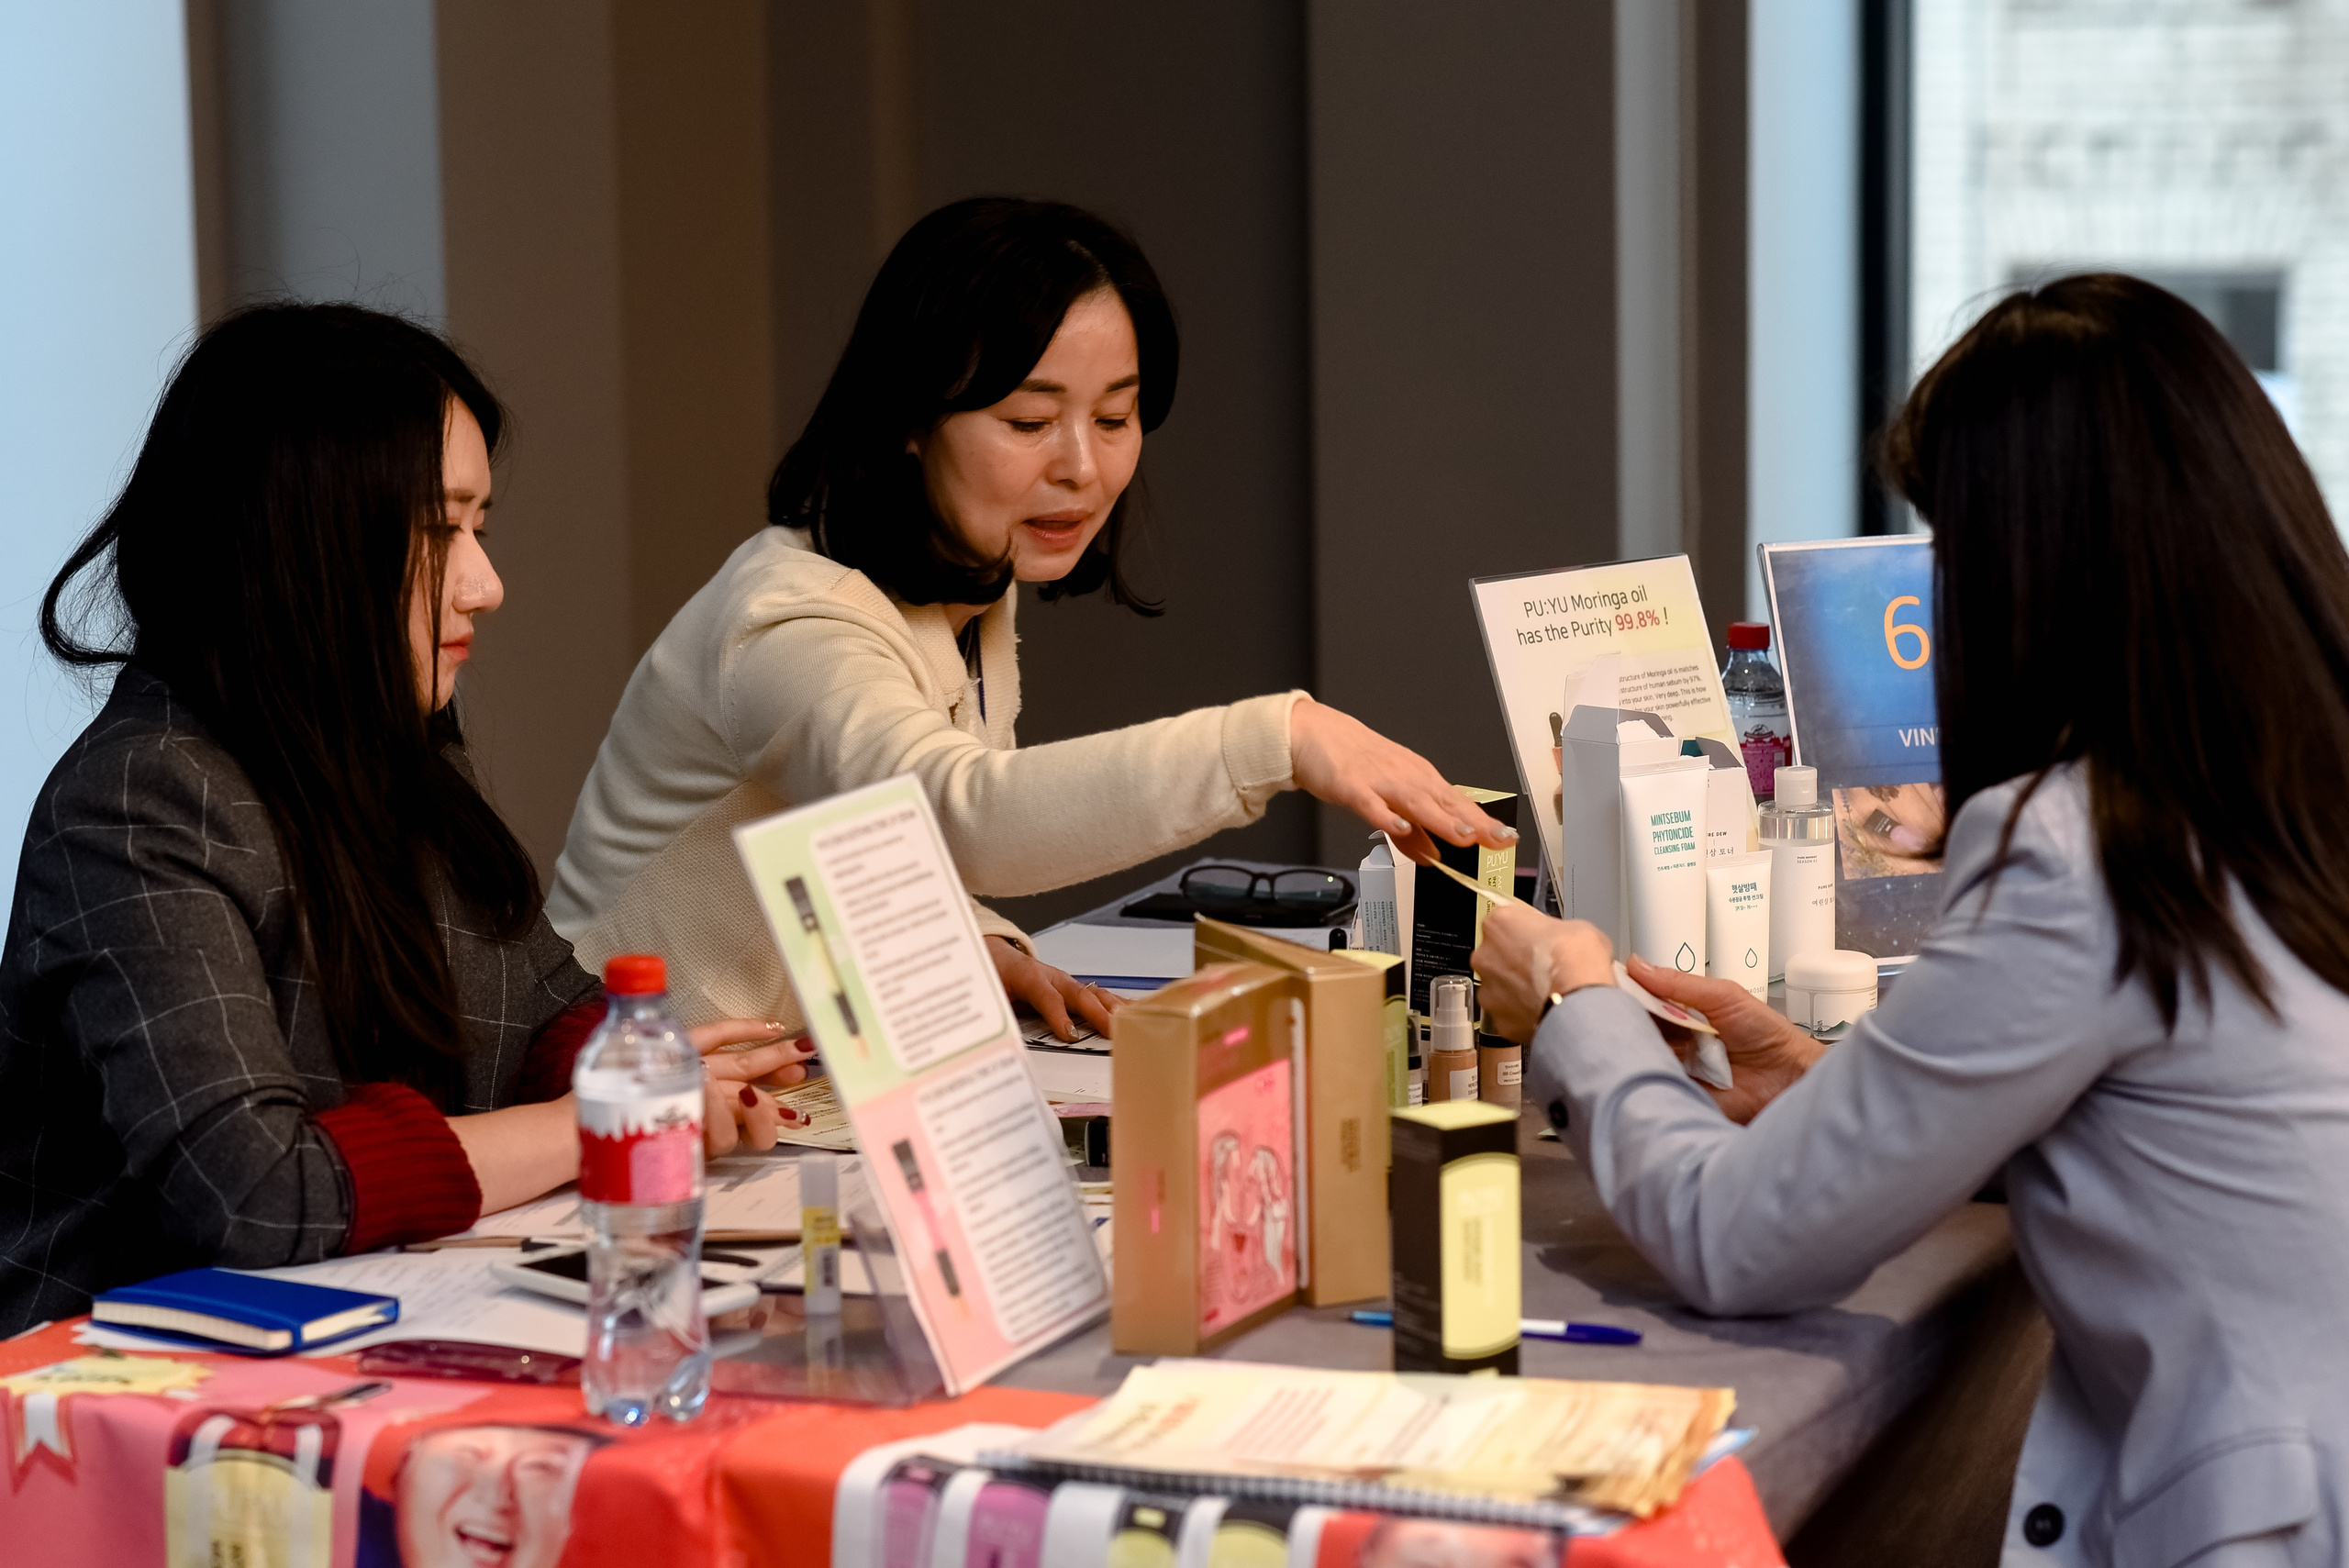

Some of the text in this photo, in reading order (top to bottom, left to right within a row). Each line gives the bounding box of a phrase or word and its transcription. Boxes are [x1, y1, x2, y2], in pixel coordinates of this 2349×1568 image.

[1523, 584, 1648, 618] PU:YU Moringa oil
[1516, 628, 1543, 646] has
[1544, 623, 1569, 641] the
[1570, 617, 1612, 638] Purity
[1615, 608, 1661, 631] 99.8%
[1883, 595, 1931, 670] 6
[1646, 669, 1667, 678] Moringa
[1678, 664, 1699, 673] matches
[1620, 684, 1642, 694] structure
[1642, 682, 1649, 690] of
[1649, 681, 1665, 689] human
[1666, 678, 1683, 686] sebum
[1631, 695, 1642, 705] your
[1654, 692, 1666, 700] Very
[1654, 703, 1665, 711] skin
[1665, 700, 1690, 710] powerfully
[1690, 696, 1711, 706] effective
[1898, 727, 1939, 748] VIN
[1650, 809, 1692, 827] MINTSEBUM
[1653, 826, 1694, 843] PHYTONCIDE
[1653, 841, 1696, 856] CLEANSING FOAM
